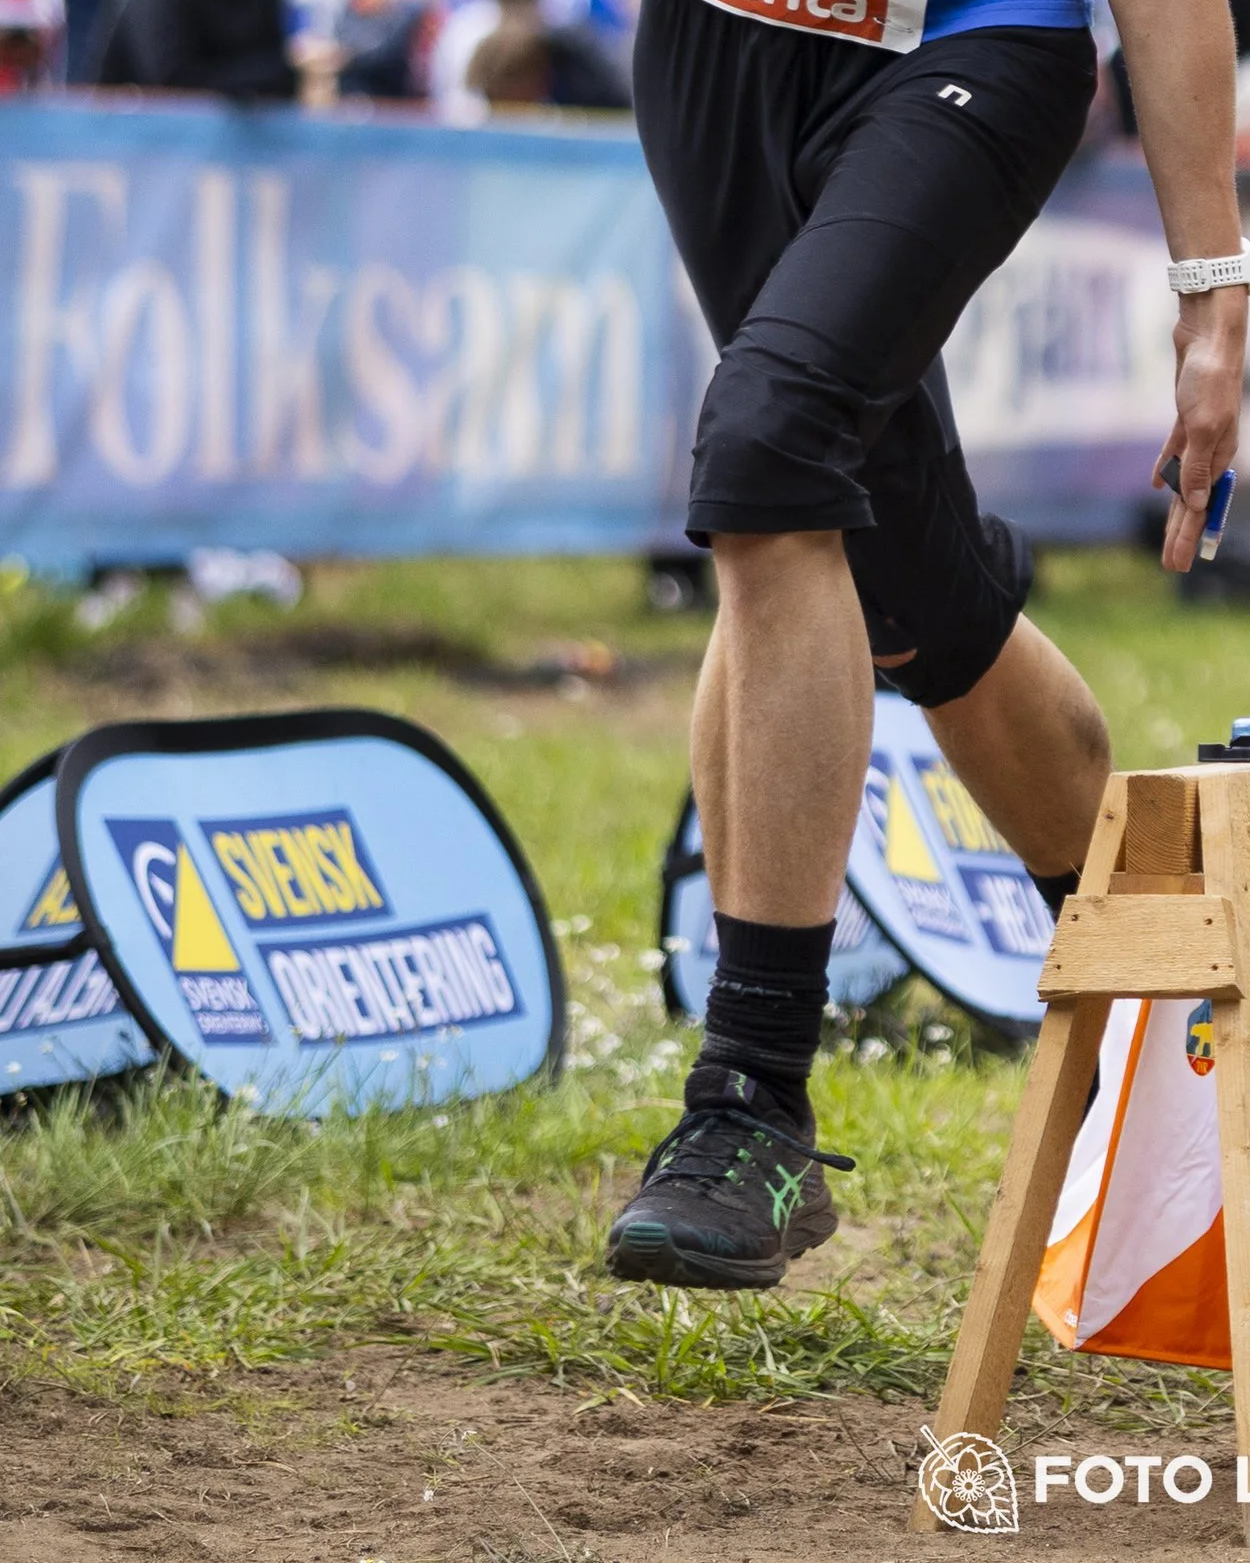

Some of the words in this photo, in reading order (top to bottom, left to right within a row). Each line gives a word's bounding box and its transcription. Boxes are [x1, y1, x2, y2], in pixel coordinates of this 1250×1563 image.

[5, 158, 641, 489] Folksam
[211, 822, 384, 920] SVENSK
[268, 923, 515, 1038] ORIENTERING
